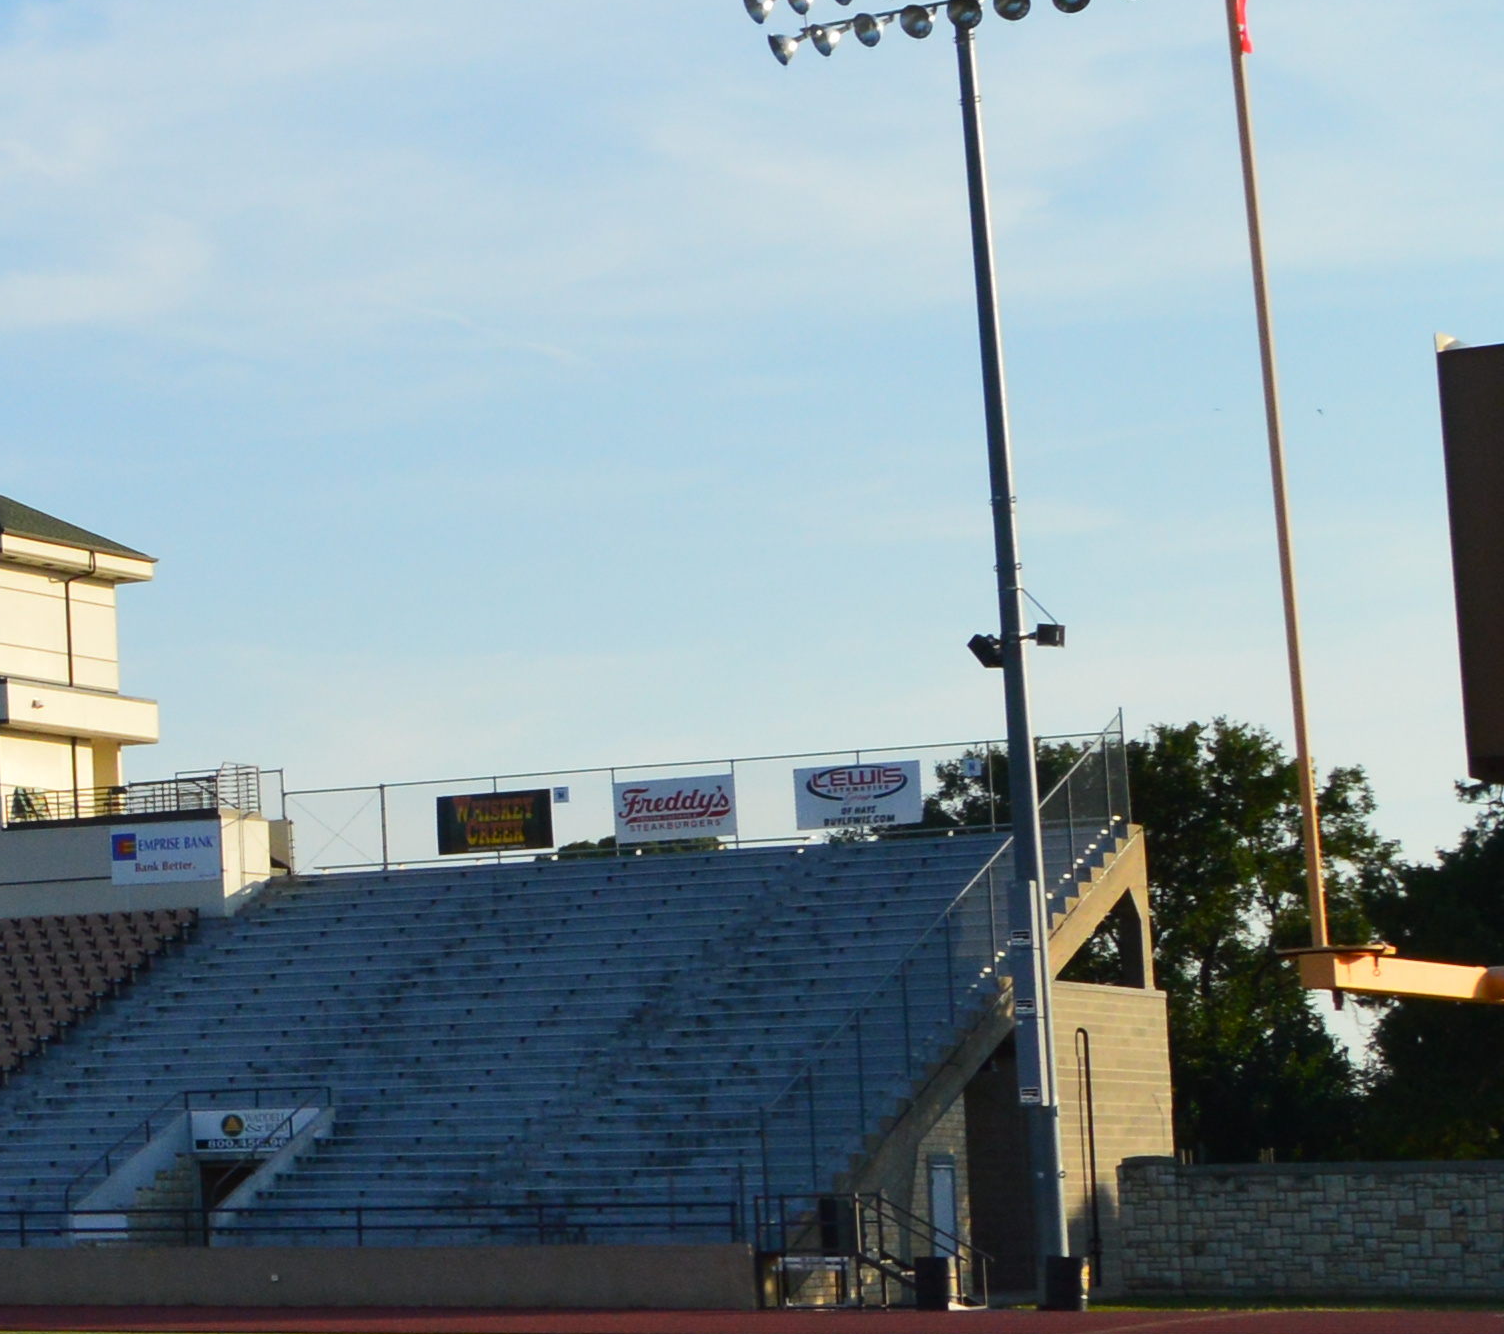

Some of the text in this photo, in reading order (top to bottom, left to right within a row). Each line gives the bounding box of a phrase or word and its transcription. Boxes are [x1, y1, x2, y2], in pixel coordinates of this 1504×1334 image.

[812, 768, 902, 788] LEWIS
[453, 796, 535, 822] WHISKEY
[618, 785, 730, 819] Freddy's
[841, 807, 852, 815] OF
[465, 819, 526, 845] CREEK
[629, 819, 722, 832] STEAKBURGERS
[138, 836, 214, 851] EMPRISE BANK
[135, 861, 159, 872] Bank
